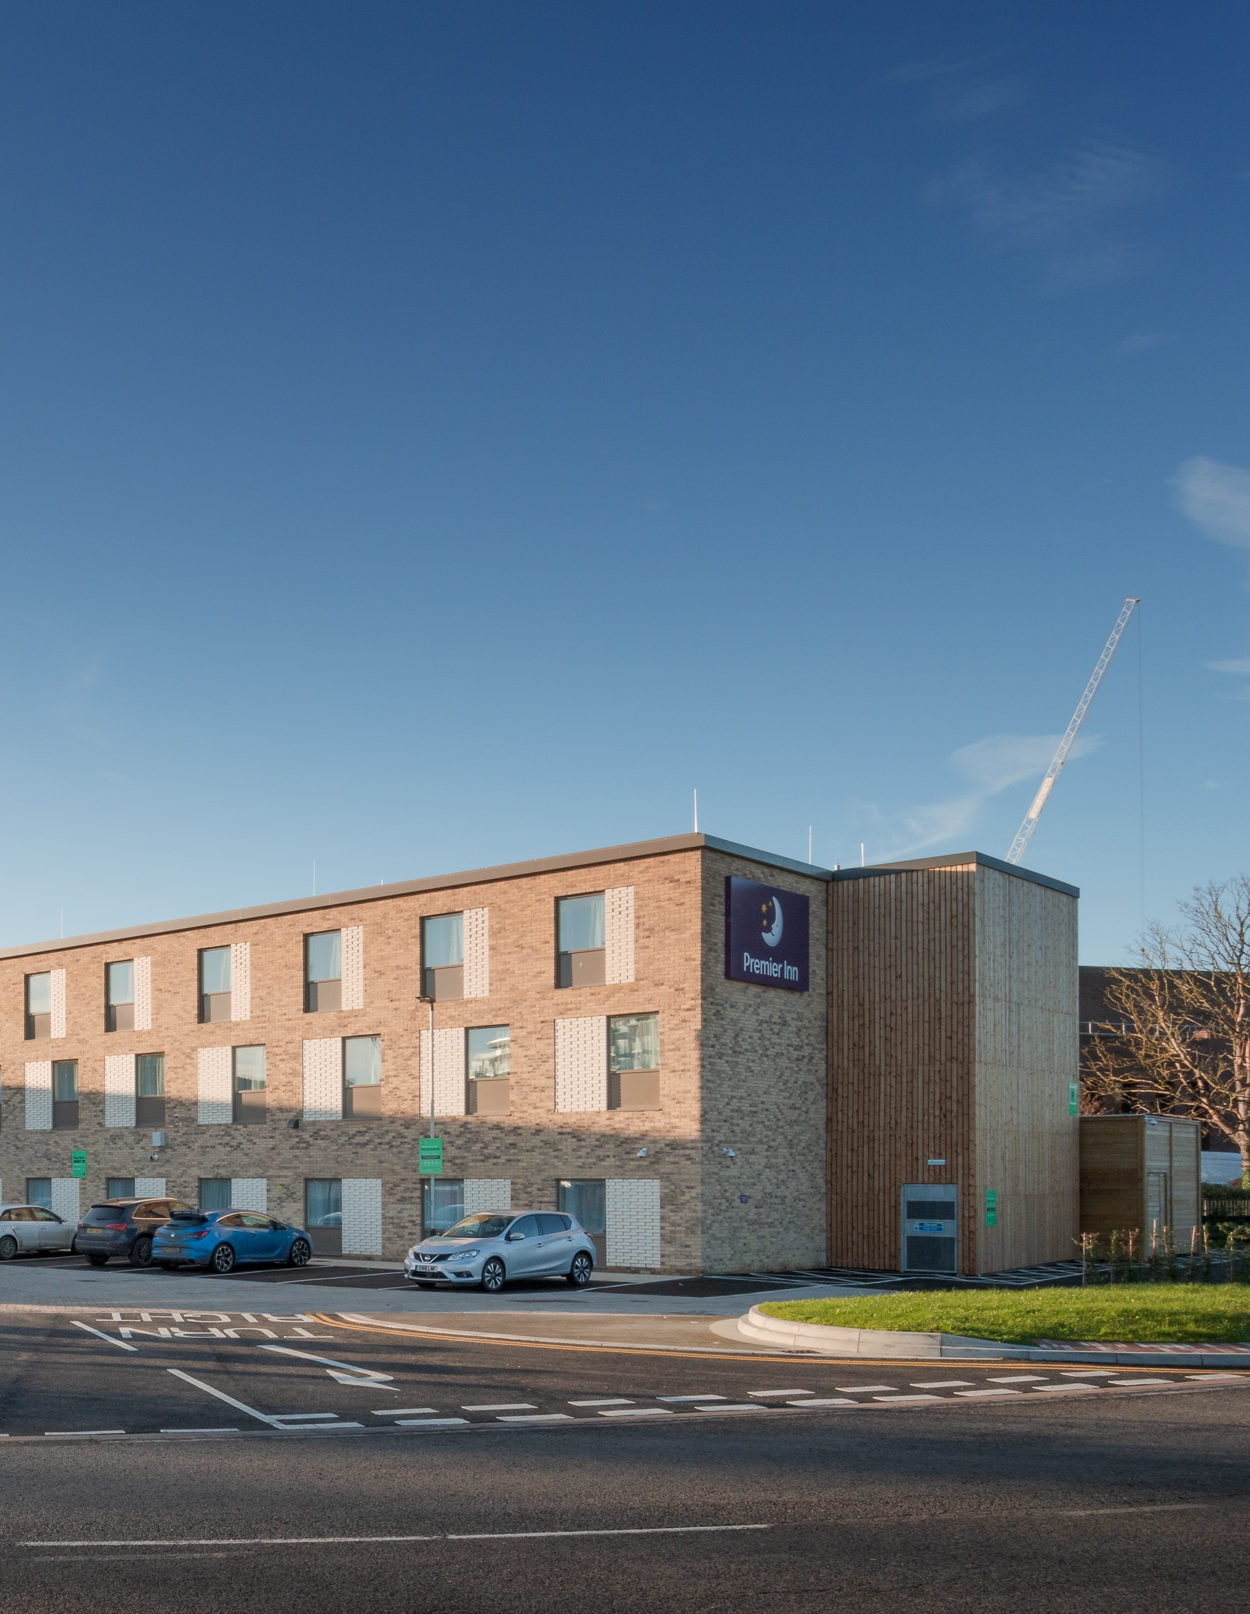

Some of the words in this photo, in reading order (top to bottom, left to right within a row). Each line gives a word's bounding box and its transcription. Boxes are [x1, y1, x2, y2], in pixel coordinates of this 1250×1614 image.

[743, 952, 783, 978] Premier
[784, 960, 799, 981] Inn
[96, 1312, 315, 1323] RIGHT
[119, 1327, 334, 1339] TURN
